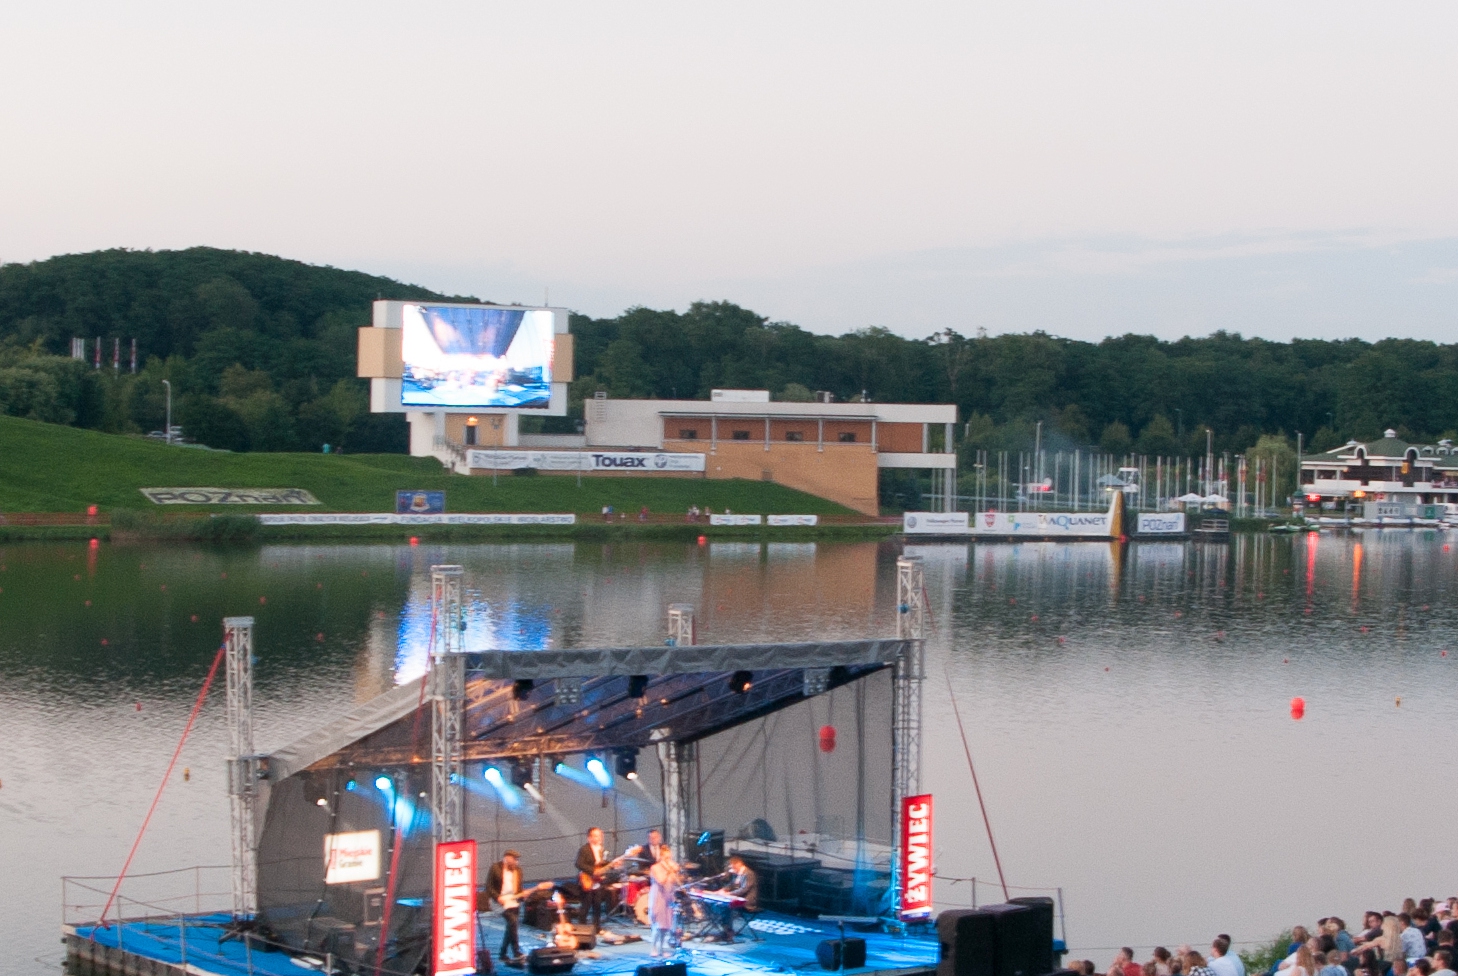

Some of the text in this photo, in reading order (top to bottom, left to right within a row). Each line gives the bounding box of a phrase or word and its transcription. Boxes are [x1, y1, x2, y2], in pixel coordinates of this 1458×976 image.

[592, 454, 646, 468] Touax
[905, 802, 928, 903] ŻYWIEC
[440, 851, 471, 964] ŻYWIEC
